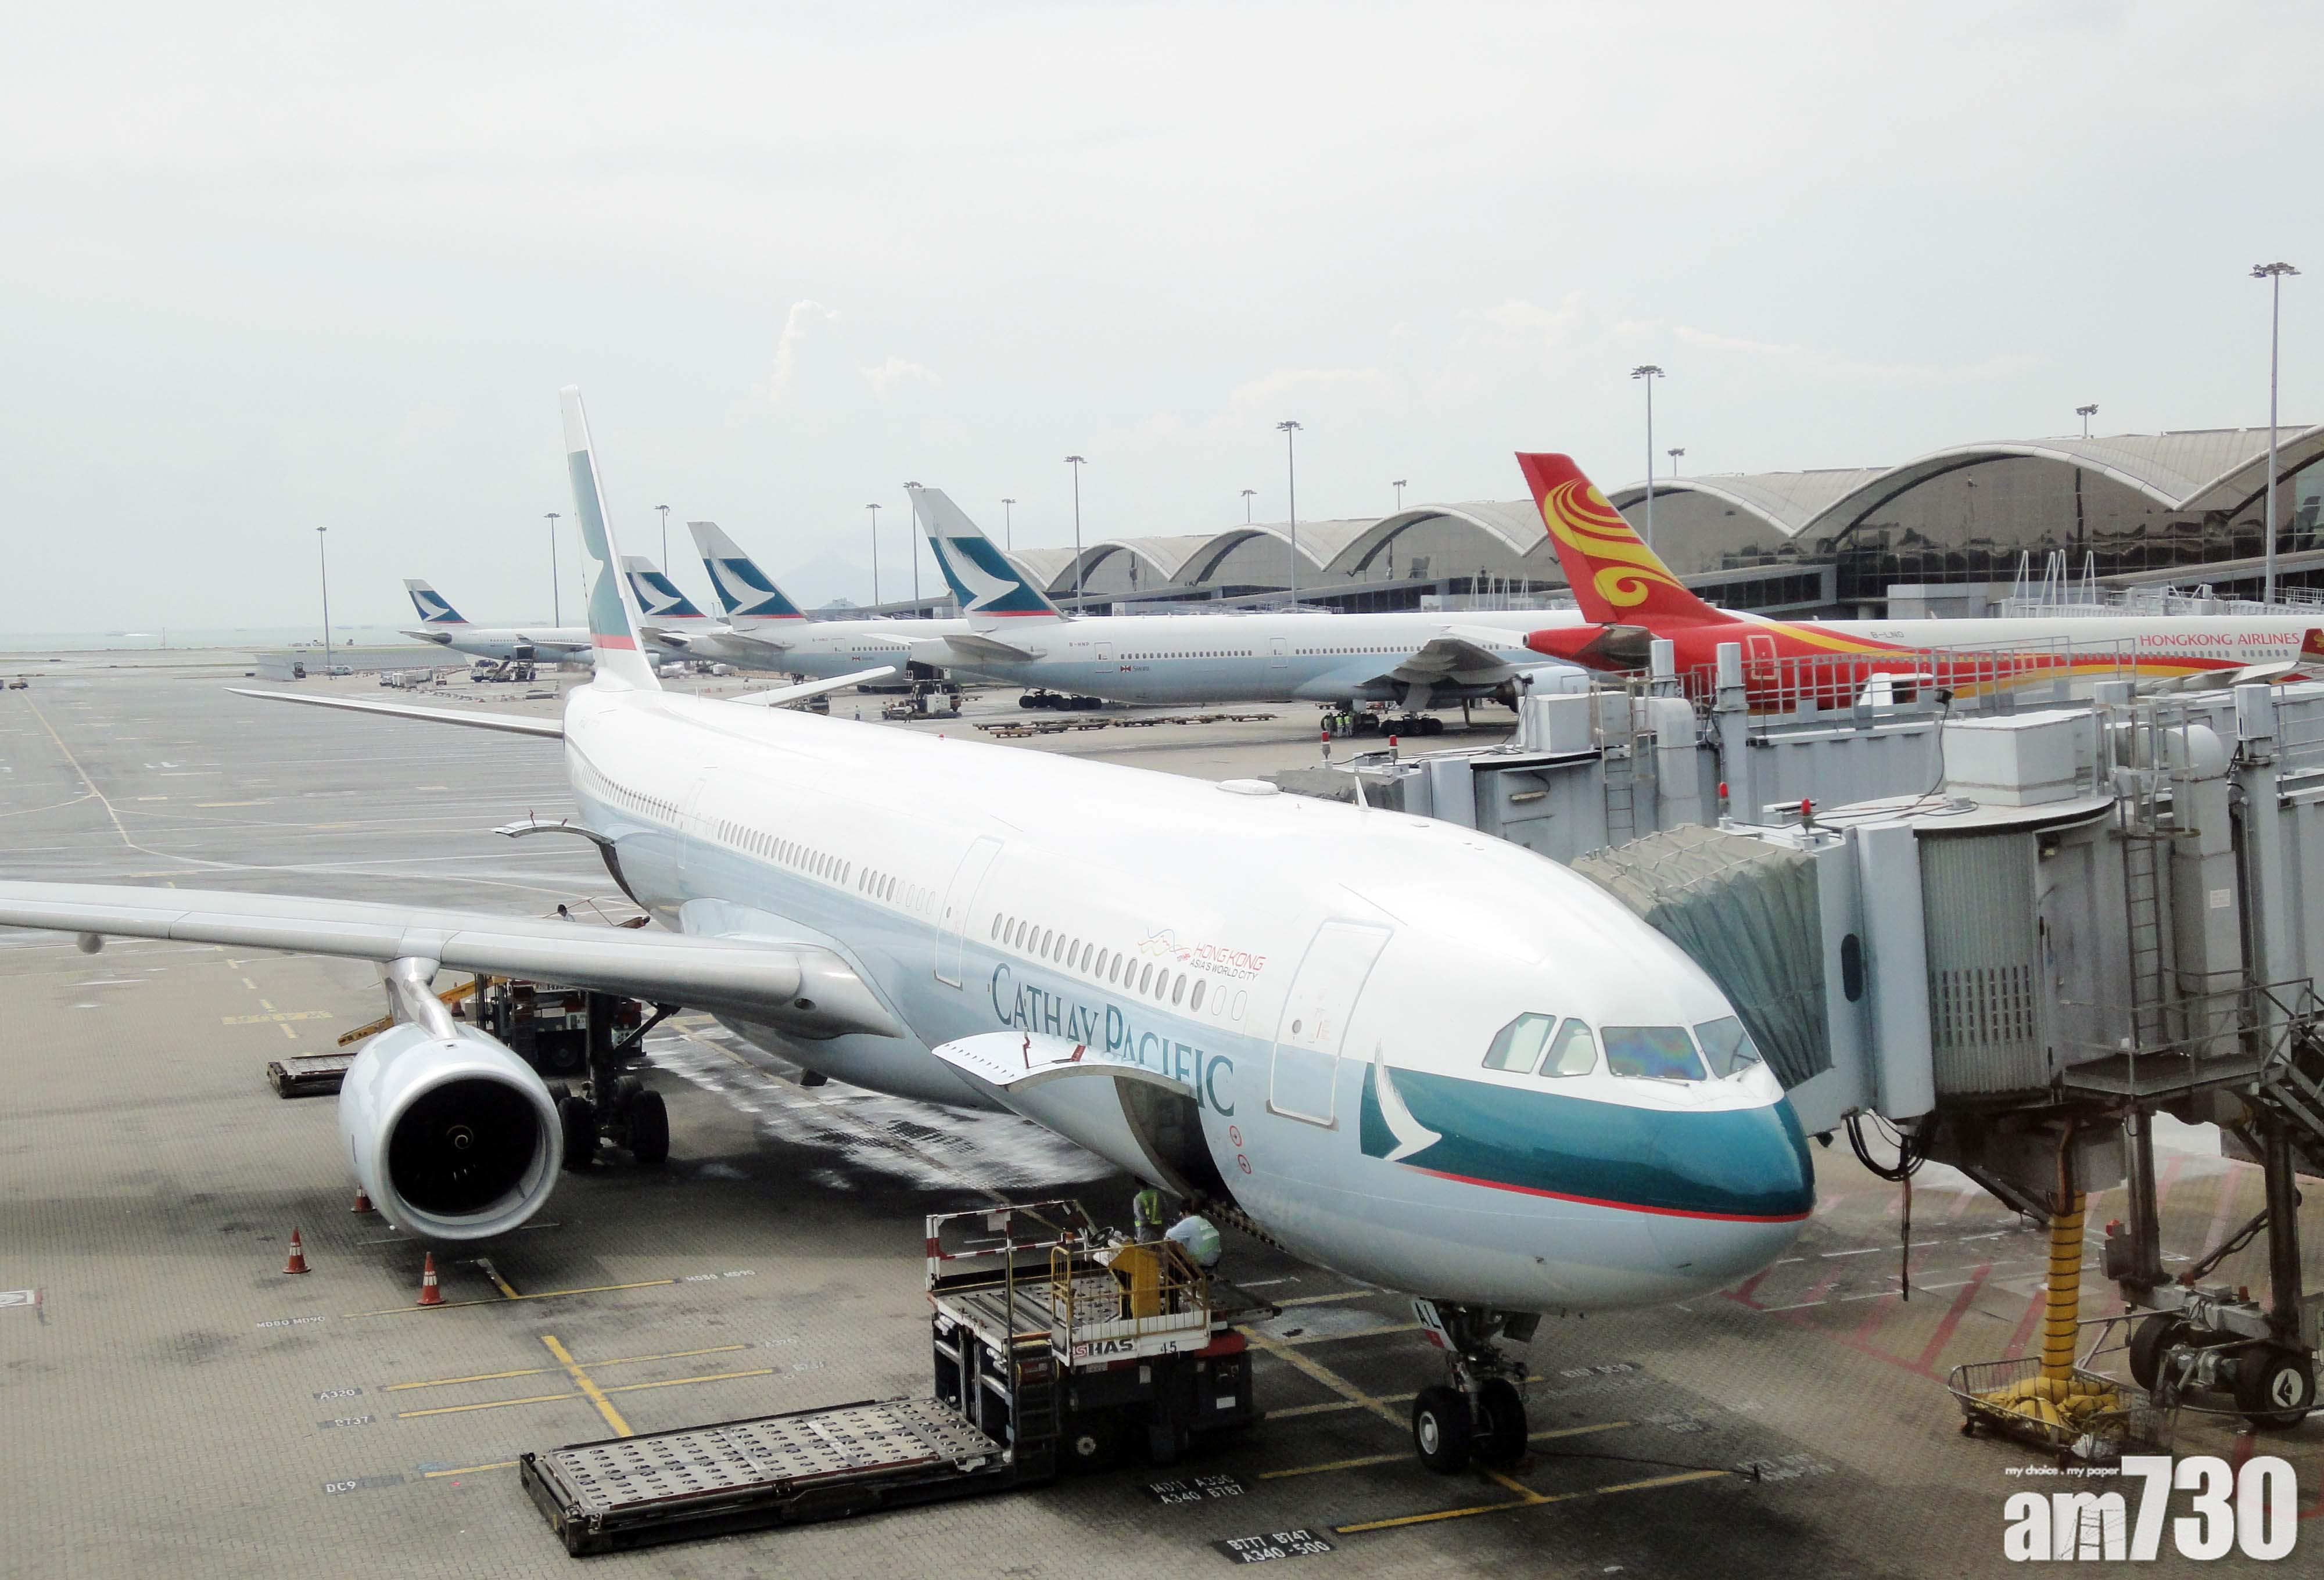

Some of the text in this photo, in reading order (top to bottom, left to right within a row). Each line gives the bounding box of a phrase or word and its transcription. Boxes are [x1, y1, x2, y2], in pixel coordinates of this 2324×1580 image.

[2140, 632, 2300, 647] HONGKONG AIRLINES
[1193, 942, 1267, 971] HONG KONG
[1190, 958, 1259, 981] ASIA'S WORLD CITY
[991, 962, 1235, 1117] CATHAY PACIFIC
[320, 1389, 356, 1399] A320
[334, 1416, 368, 1427] B737
[325, 1480, 357, 1493] DC9
[1160, 1491, 1202, 1504] A340
[1226, 1529, 1311, 1550] B777 B747
[1242, 1546, 1286, 1563] A340
